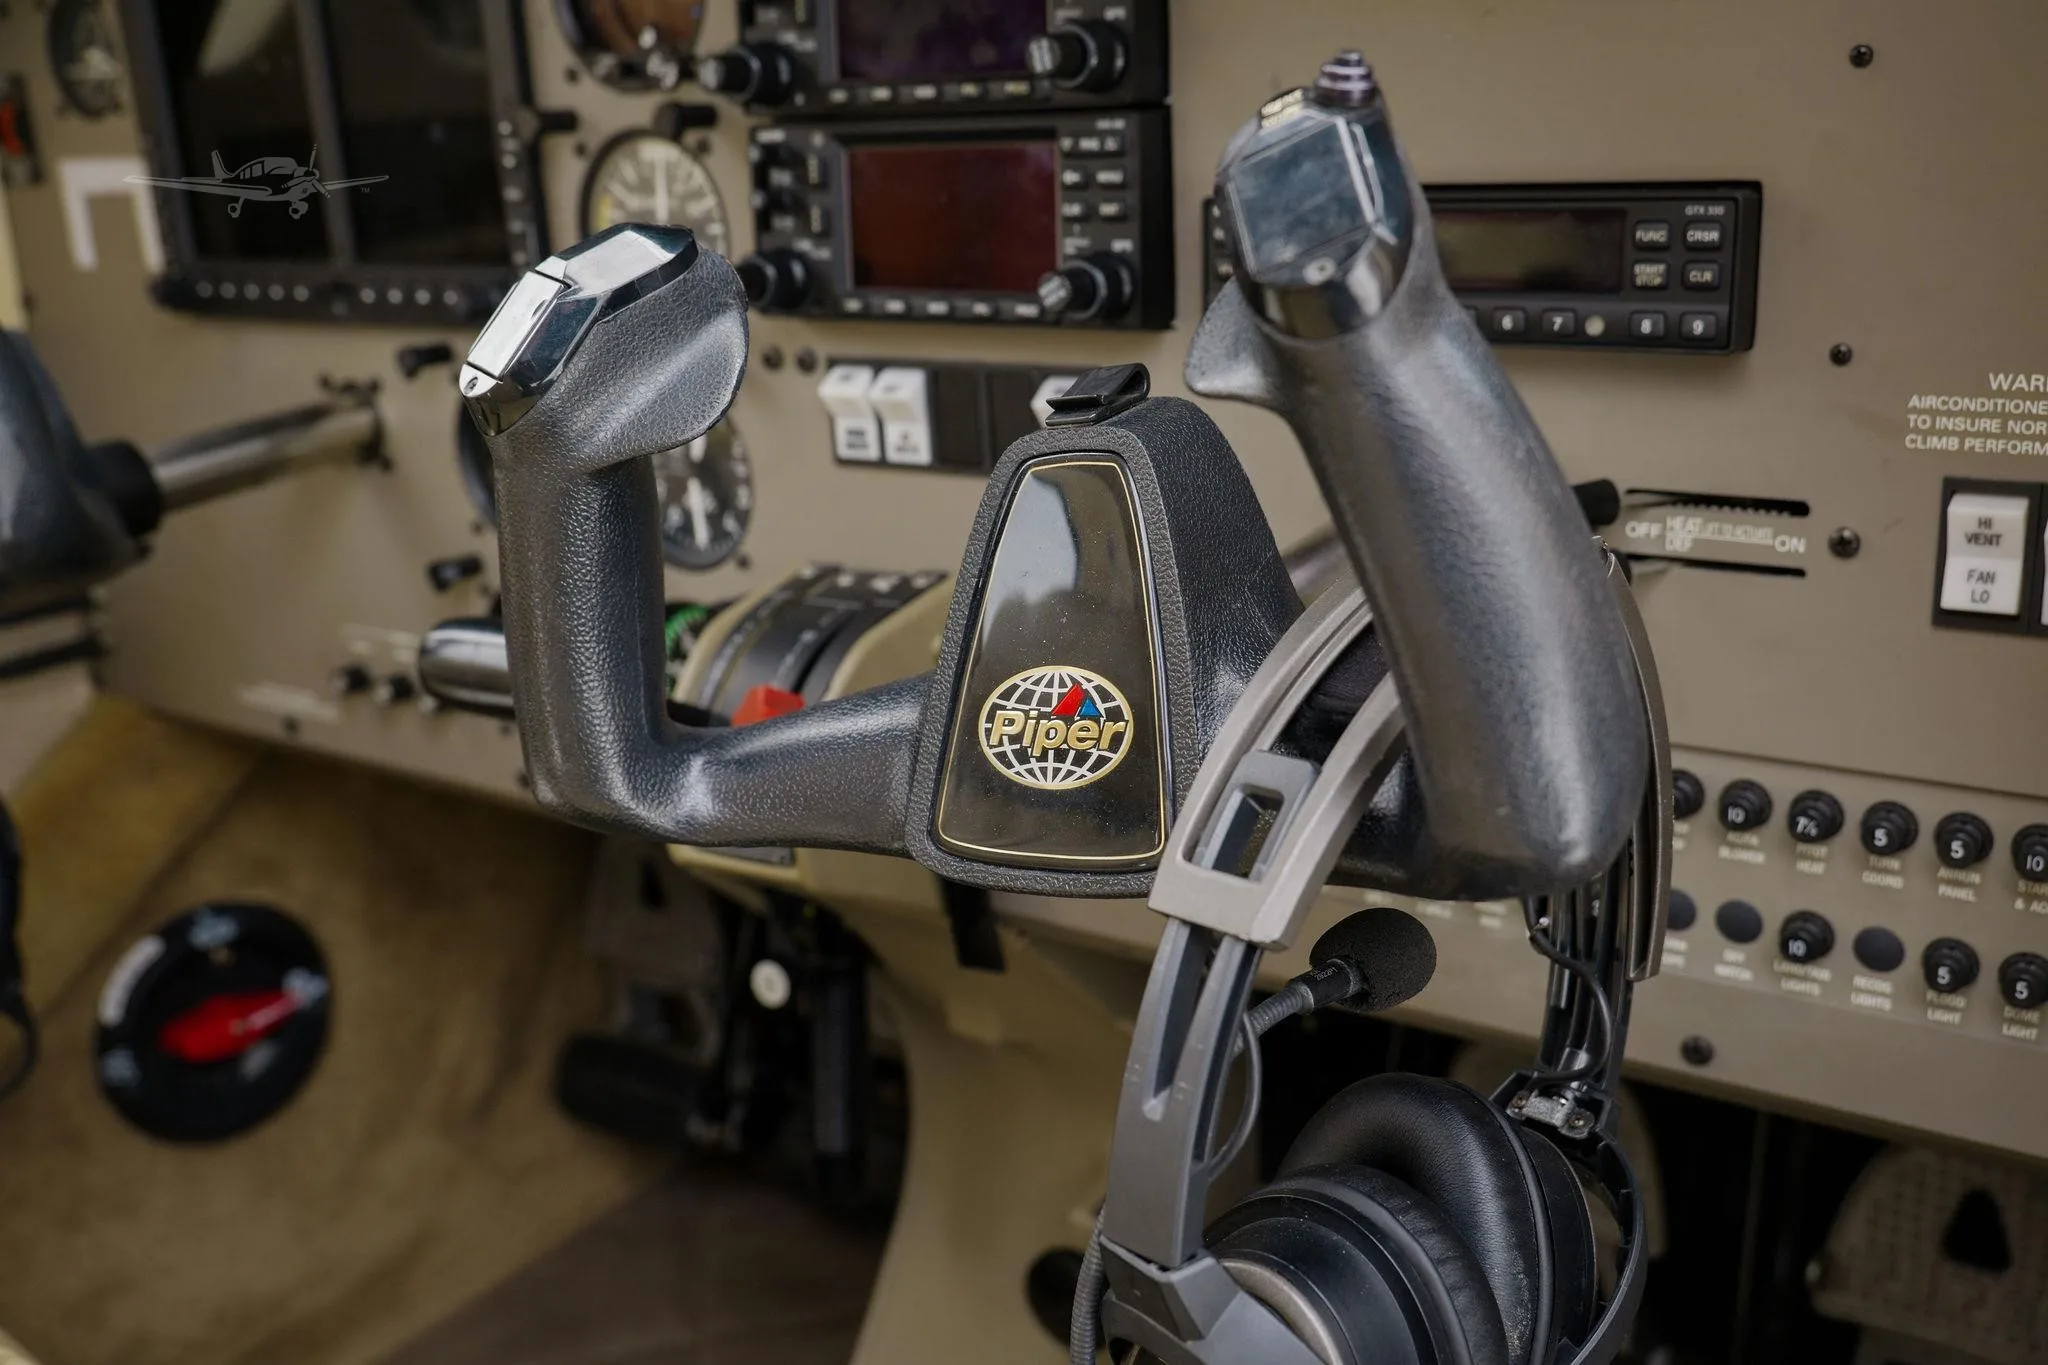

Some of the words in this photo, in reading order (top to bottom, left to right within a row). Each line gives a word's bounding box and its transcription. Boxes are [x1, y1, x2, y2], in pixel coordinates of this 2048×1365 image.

[1635, 230, 1667, 243] FUNC
[1686, 230, 1719, 243] CRSR
[1689, 269, 1713, 283] CLR
[1501, 314, 1514, 331] 6
[1552, 316, 1564, 332] 7
[1640, 318, 1652, 335] 8
[1692, 319, 1704, 336] 9
[1988, 372, 2048, 393] WAR
[1906, 414, 1932, 430] TO
[1935, 416, 2003, 433] INSURE
[1904, 433, 1960, 451] CLIMB
[1625, 520, 1663, 539] OFF
[1666, 515, 1703, 533] HEAT
[1978, 516, 1992, 530] HI
[1774, 534, 1806, 554] ON
[1965, 532, 2002, 547] VENT
[1966, 569, 1996, 585] FAN
[1970, 589, 1990, 604] LO
[989, 709, 1127, 757] Piper
[1727, 805, 1746, 824] 10
[1873, 828, 1889, 848] 5
[1950, 840, 1965, 859] 5
[2026, 855, 2045, 872] 10
[1937, 884, 1977, 902] PANEL
[1788, 938, 1807, 957] 10
[1937, 965, 1951, 985] 5
[2015, 980, 2029, 1000] 5
[1926, 1008, 1962, 1026] LIGHT
[2003, 1023, 2038, 1041] LIGHT
